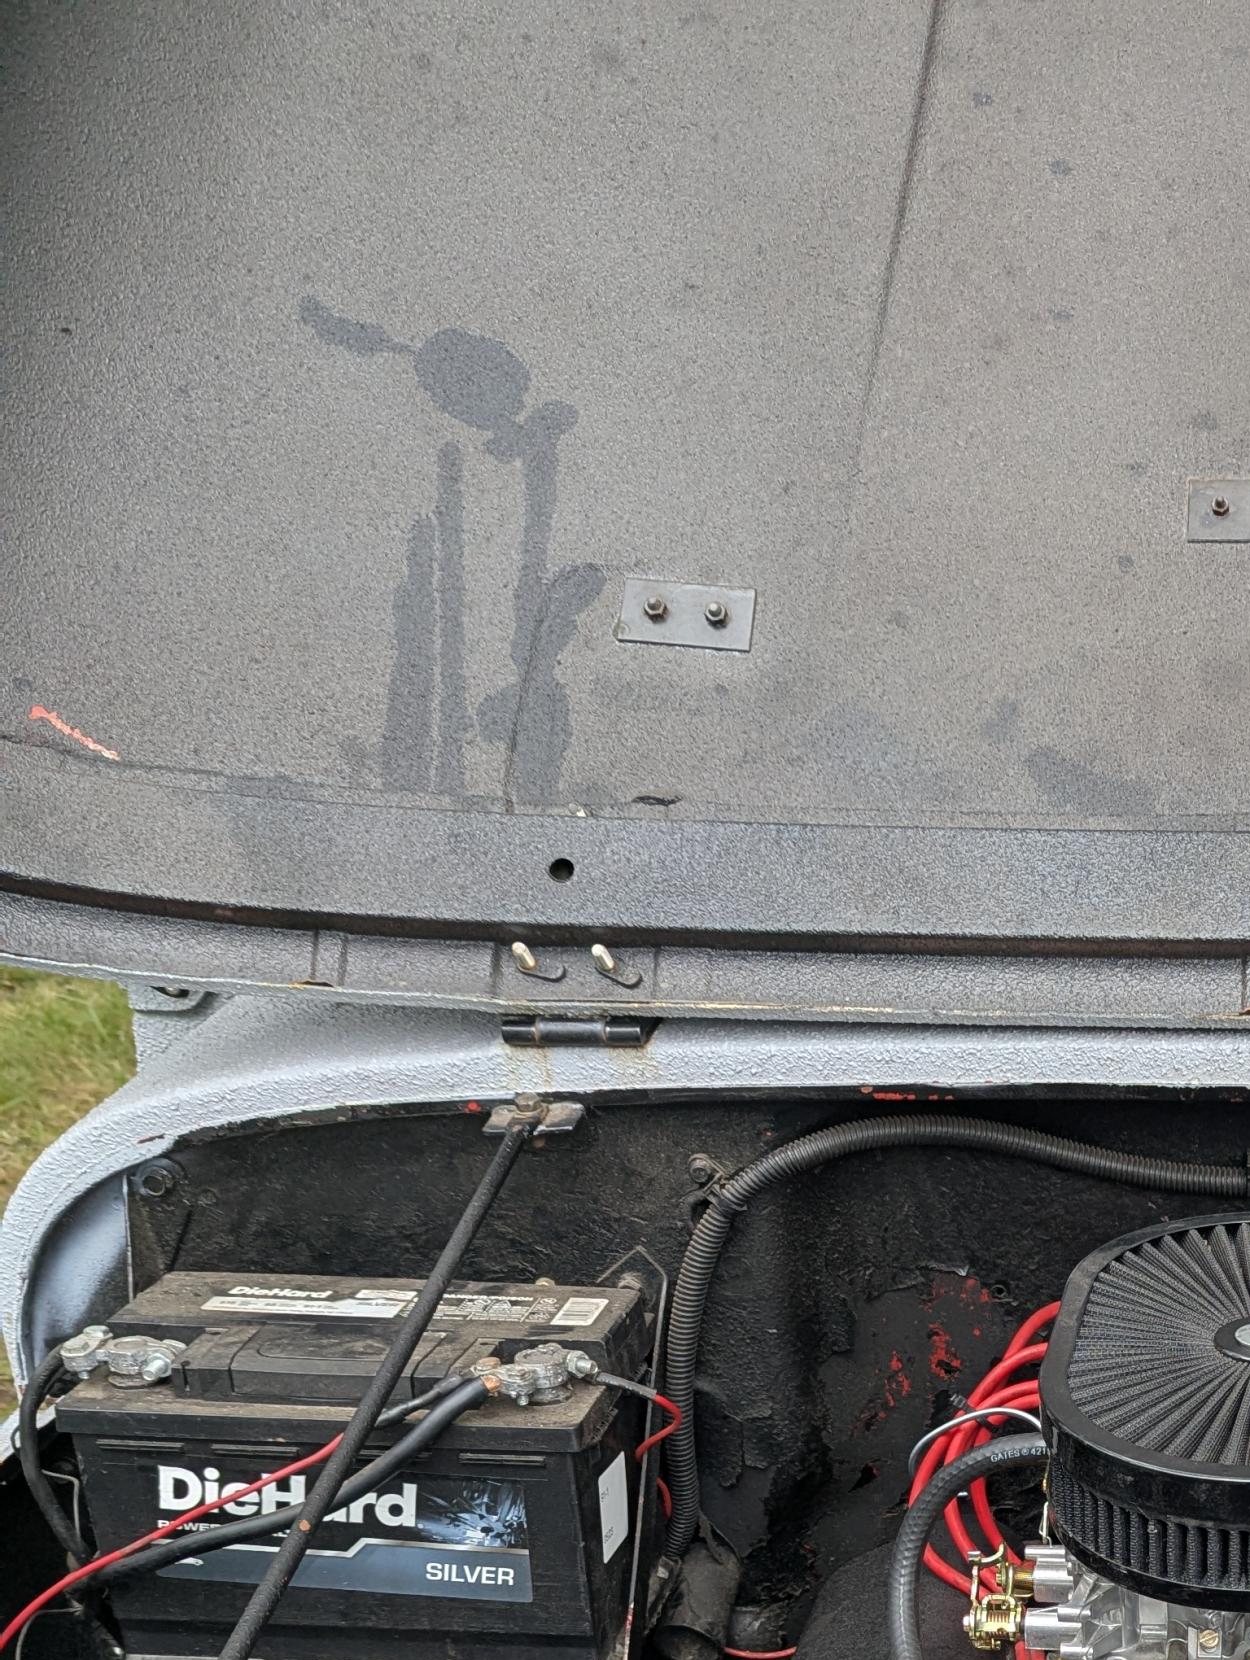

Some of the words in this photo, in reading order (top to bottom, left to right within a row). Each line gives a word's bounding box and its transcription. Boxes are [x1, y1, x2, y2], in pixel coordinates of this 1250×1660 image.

[227, 1286, 333, 1298] DieHard
[990, 1447, 1020, 1463] GATES
[1030, 1445, 1049, 1456] 421
[157, 1465, 418, 1527] DieHrd
[425, 1562, 515, 1586] SILVER
